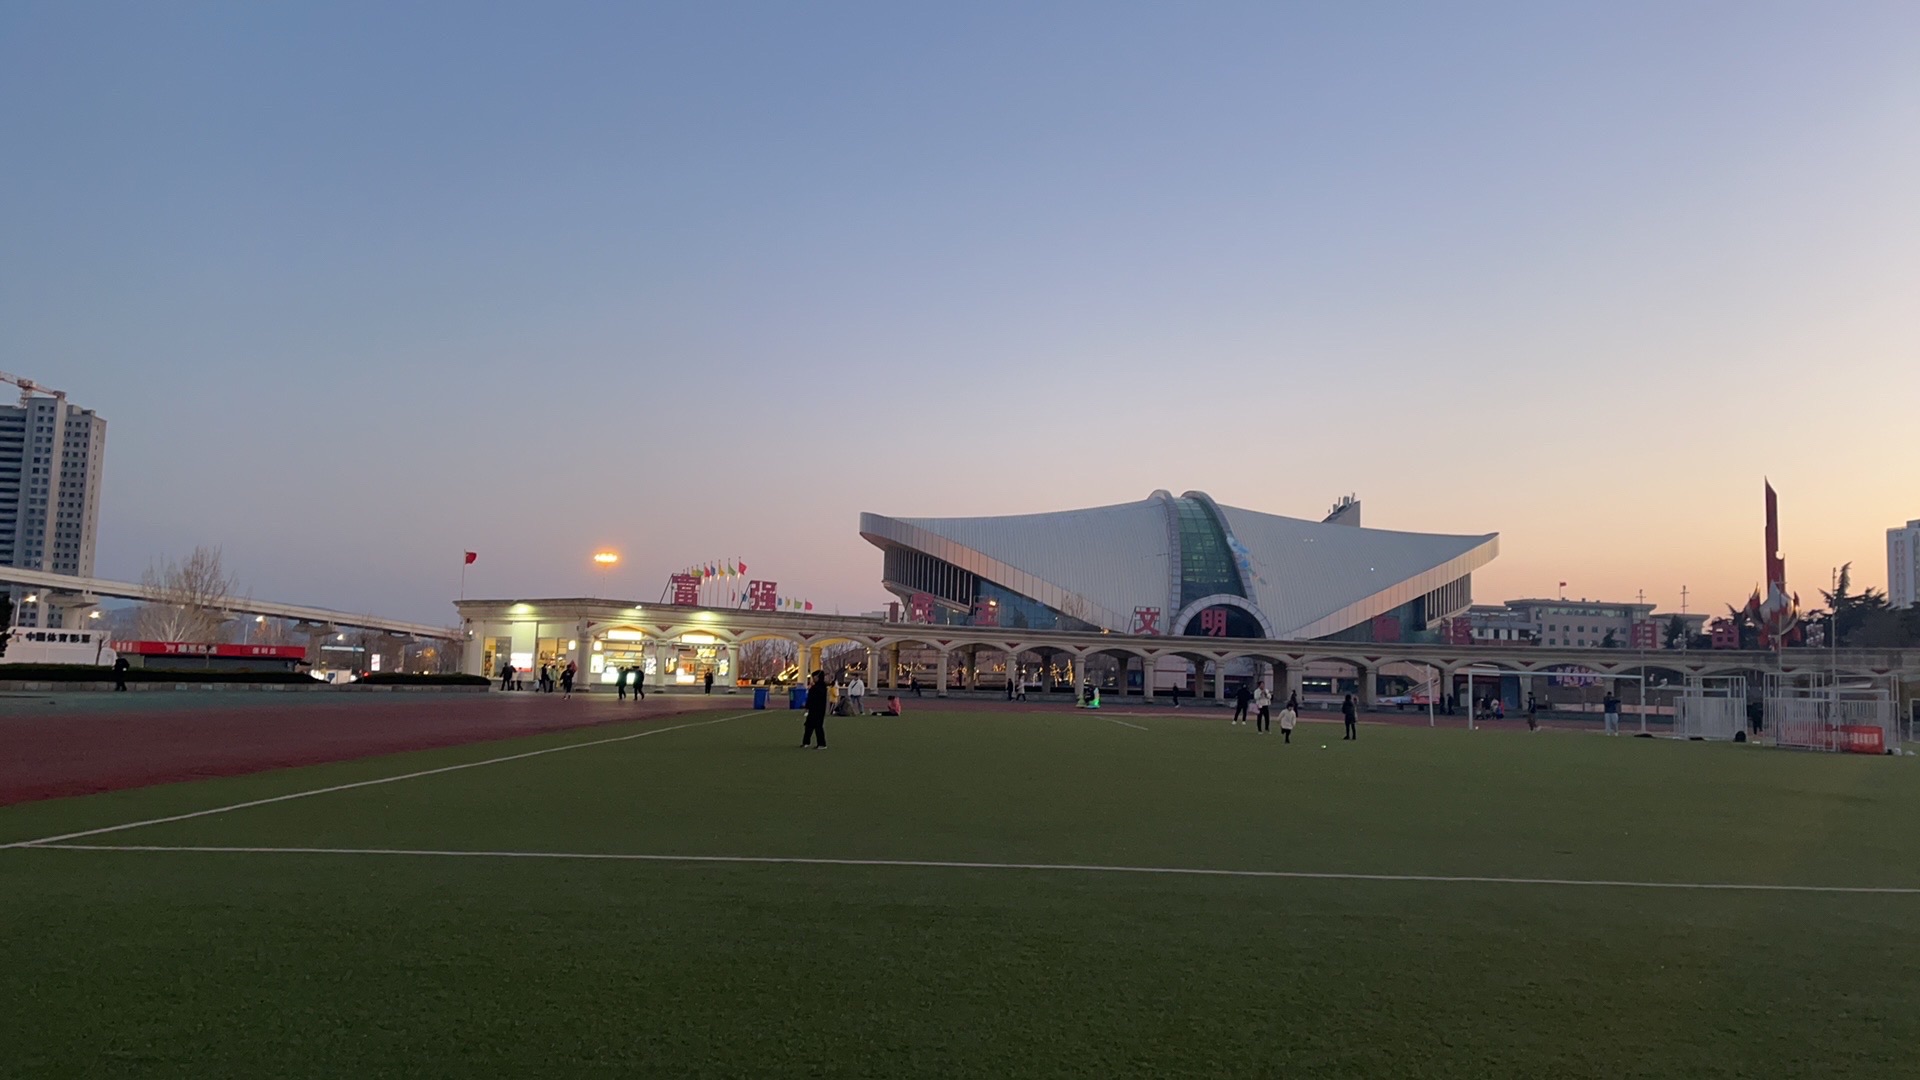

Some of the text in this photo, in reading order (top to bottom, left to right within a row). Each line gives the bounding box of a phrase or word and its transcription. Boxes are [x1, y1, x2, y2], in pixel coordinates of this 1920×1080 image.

[671, 574, 778, 612] 富强
[26, 631, 91, 643] 中国体育彩票
[1134, 607, 1227, 637] 文明
